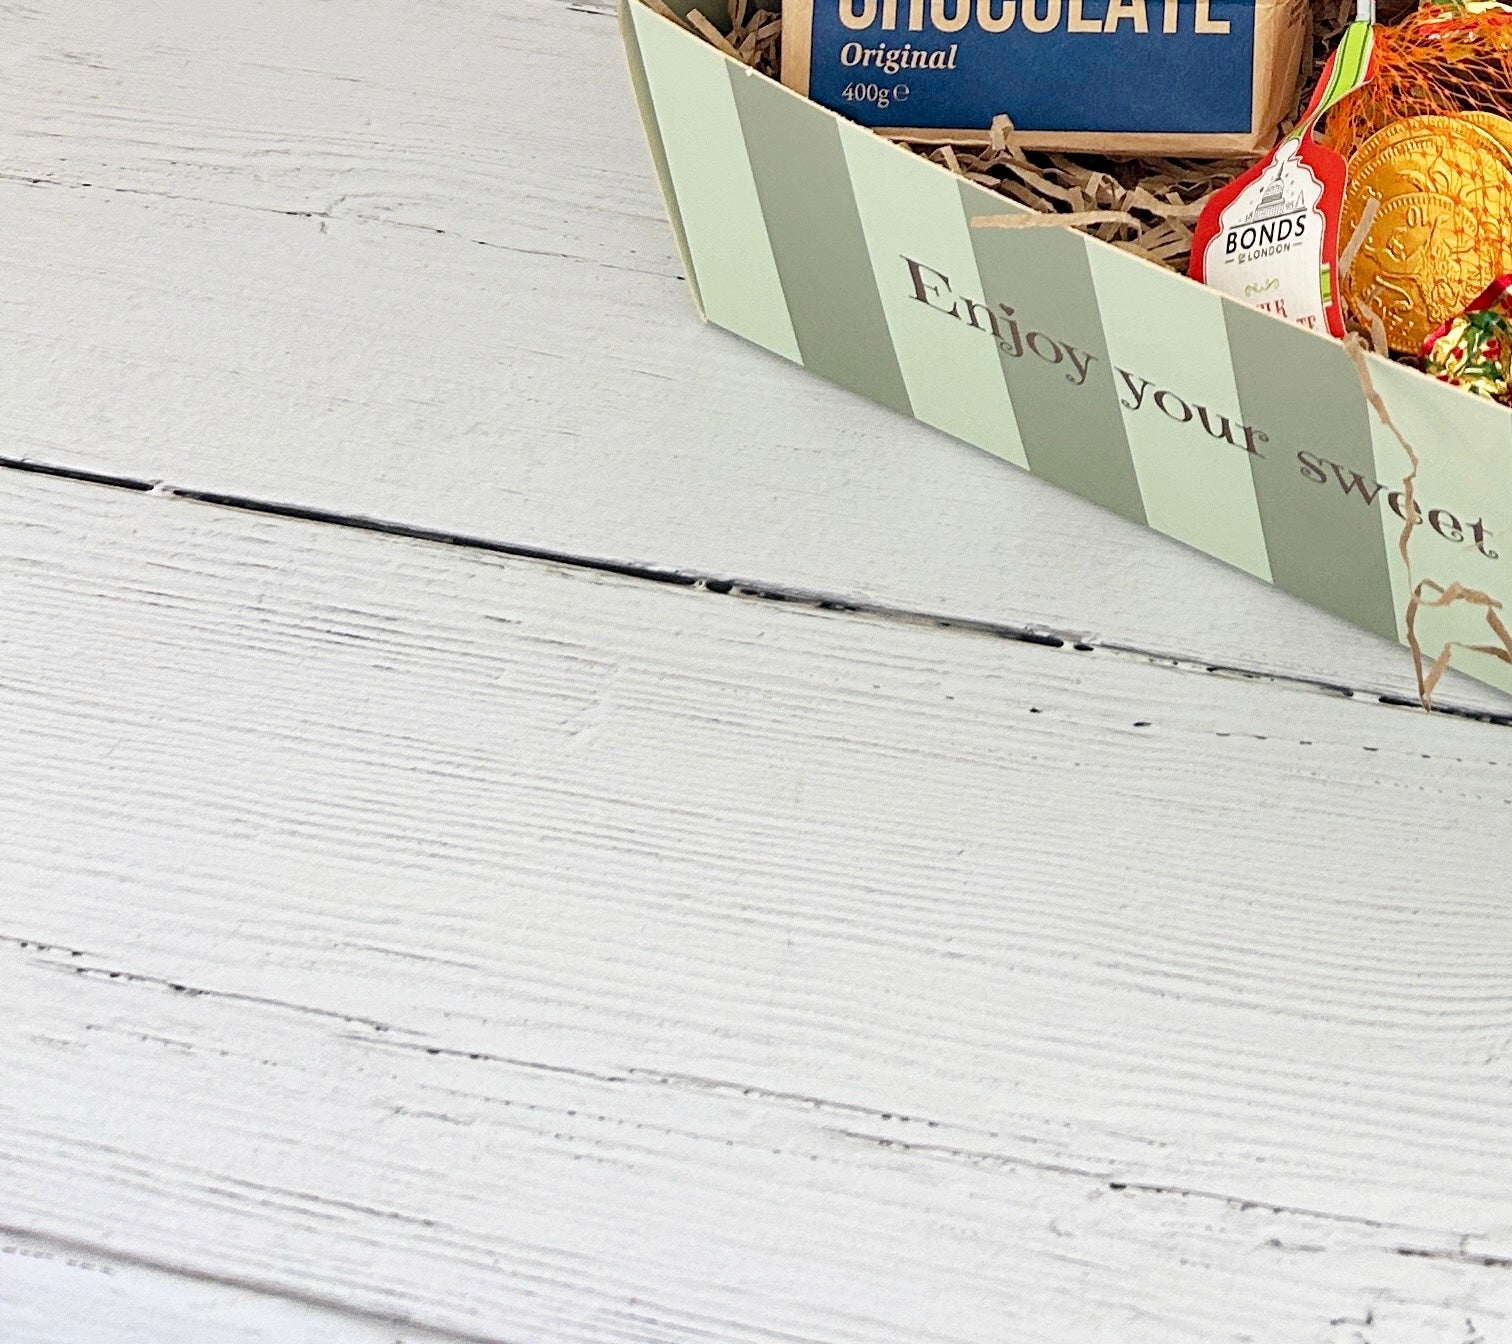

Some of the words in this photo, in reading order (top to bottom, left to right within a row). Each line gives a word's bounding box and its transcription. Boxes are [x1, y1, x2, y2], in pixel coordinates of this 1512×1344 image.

[839, 42, 958, 75] Original
[1226, 214, 1307, 255] BONDS
[1247, 243, 1291, 262] LONDON
[899, 254, 1099, 386] Enjoy
[1114, 366, 1270, 459] your
[1296, 450, 1500, 560] sweet
